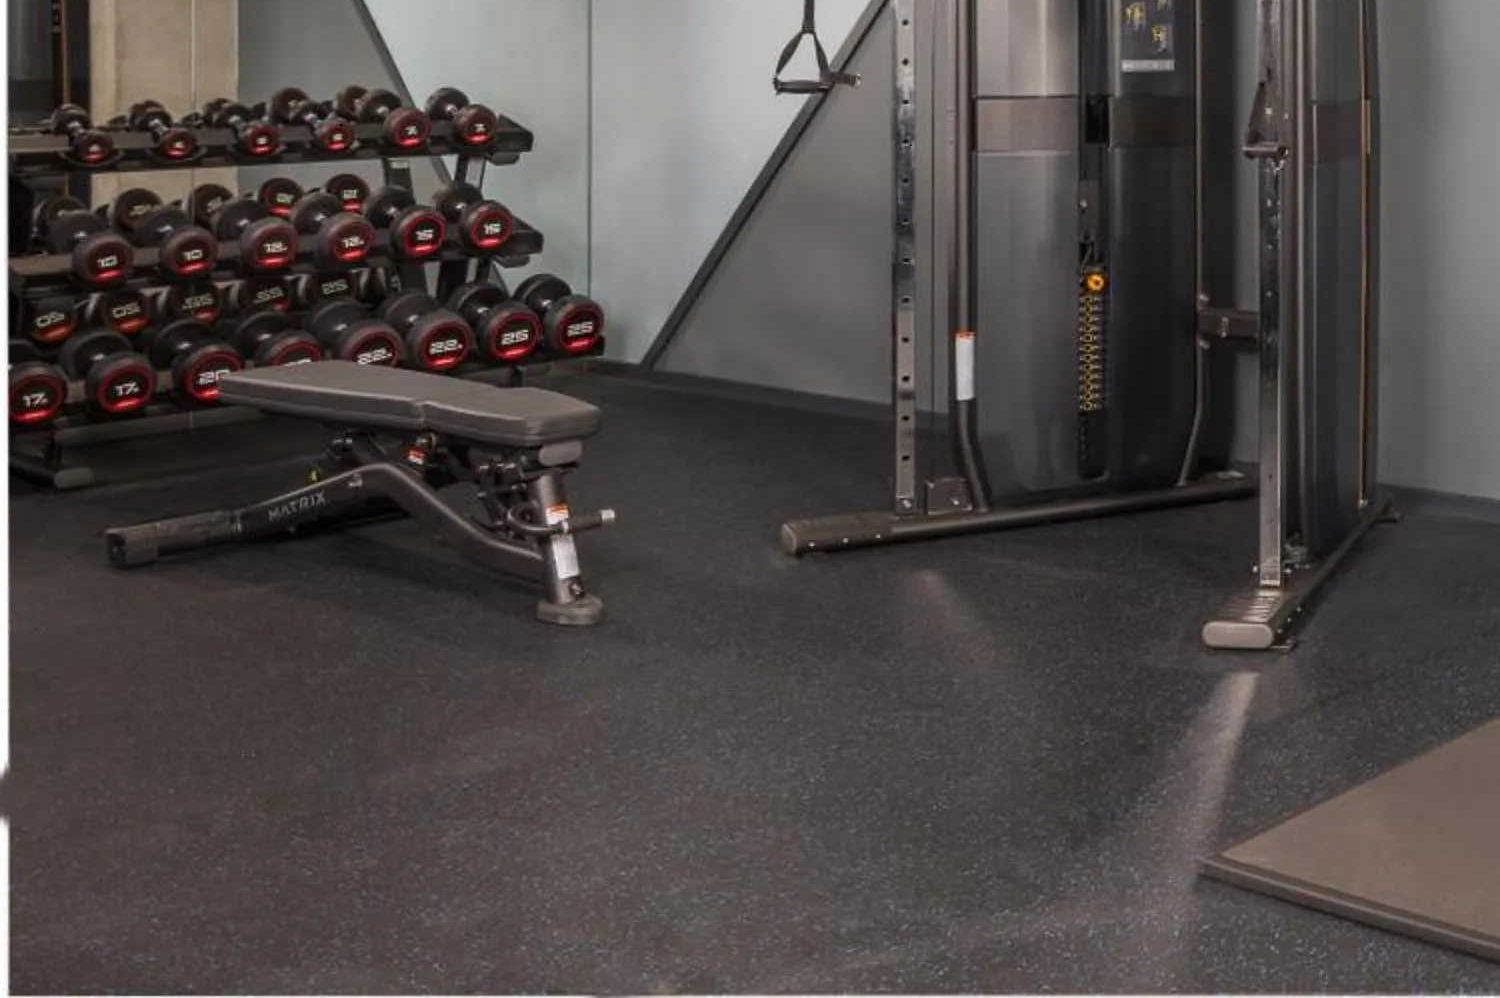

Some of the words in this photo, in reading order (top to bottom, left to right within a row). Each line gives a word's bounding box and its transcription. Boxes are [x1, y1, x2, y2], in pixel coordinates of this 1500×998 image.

[97, 255, 119, 267] 10
[183, 249, 203, 262] 10
[567, 321, 593, 337] 25
[501, 329, 529, 346] 25
[268, 491, 325, 521] MATRIX
